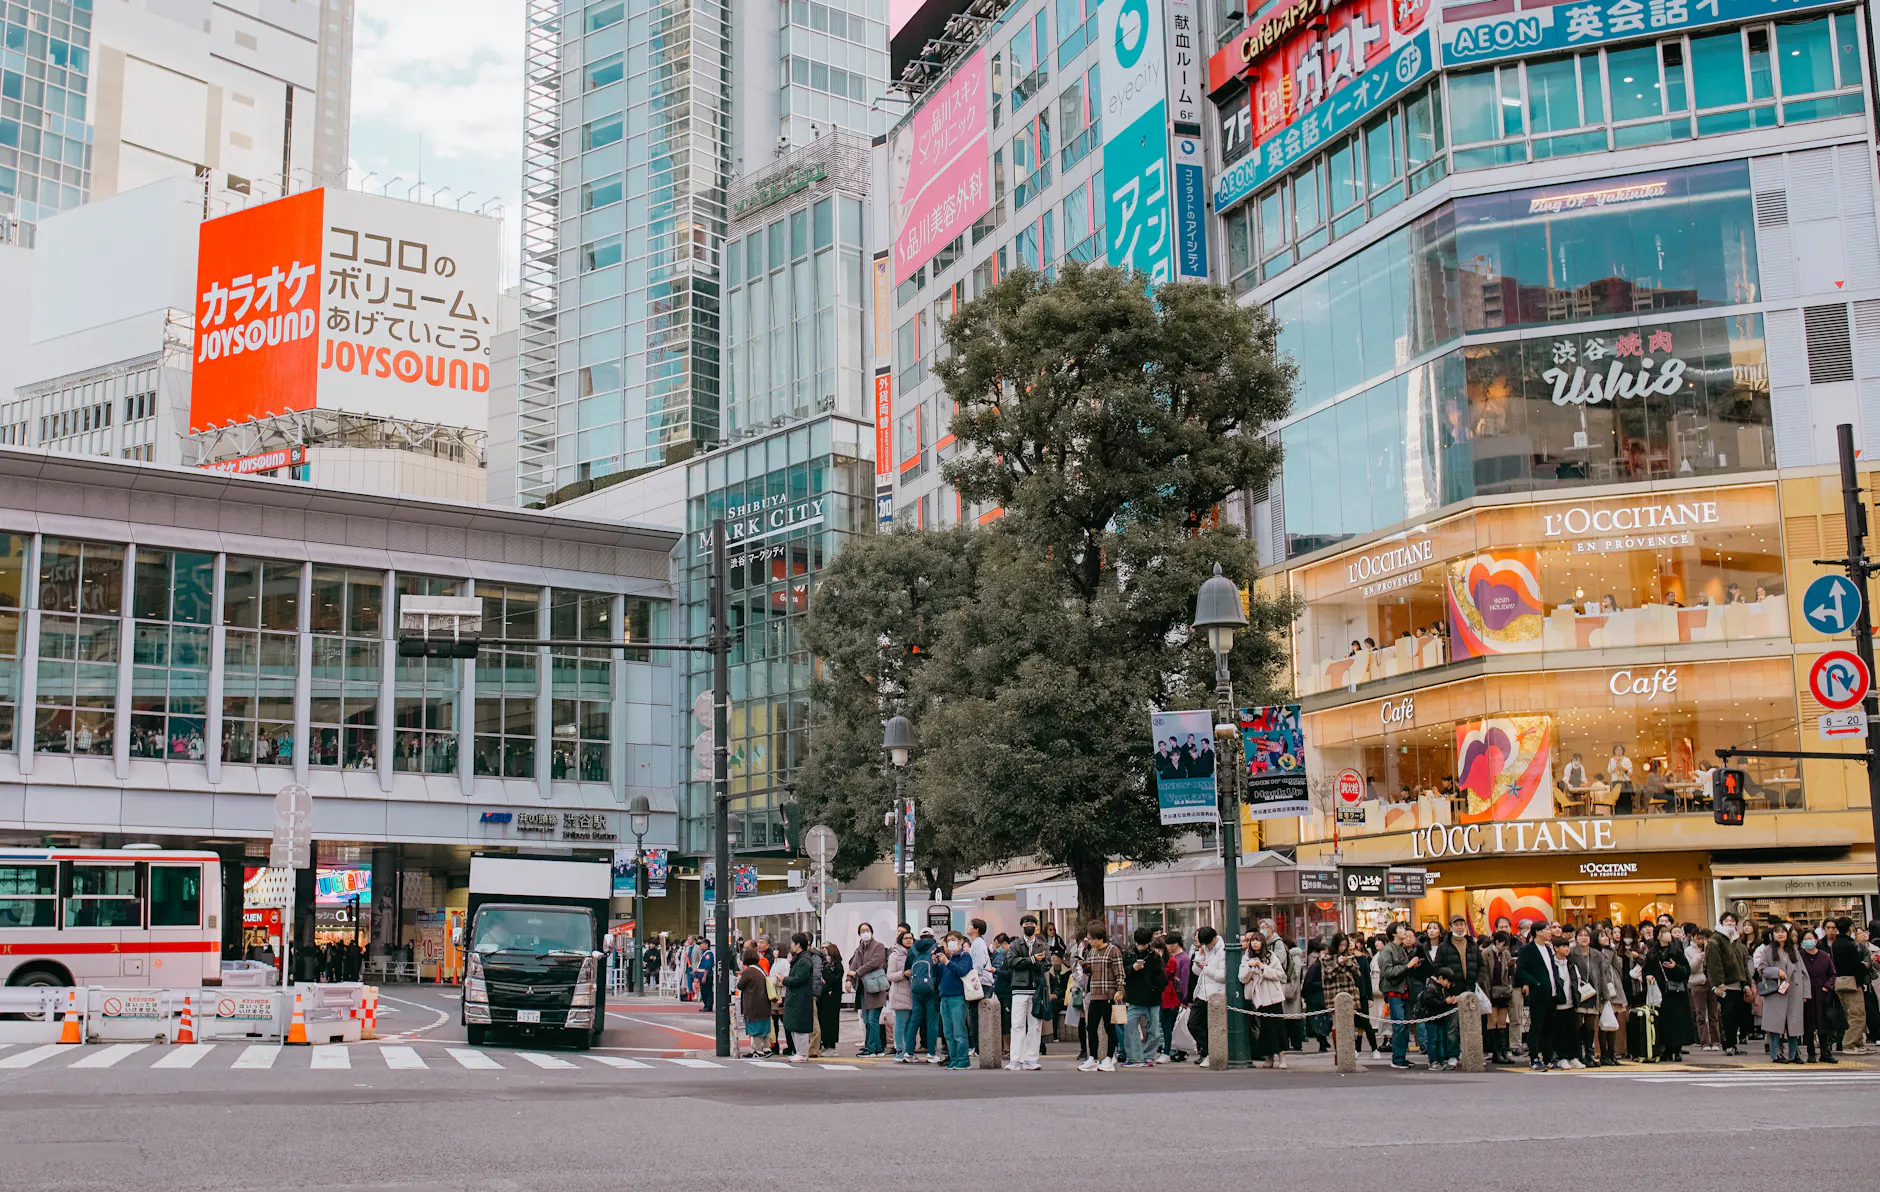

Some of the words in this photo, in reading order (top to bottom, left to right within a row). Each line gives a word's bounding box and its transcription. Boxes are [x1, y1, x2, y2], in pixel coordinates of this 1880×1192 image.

[1455, 19, 1540, 53] AEON
[1174, 14, 1192, 104] 献血ルーム
[1296, 16, 1381, 116] ガスト
[931, 73, 981, 137] 品川スキン
[1109, 58, 1160, 116] eyecity
[1180, 110, 1193, 120] 6F
[1223, 104, 1250, 151] 7F
[932, 105, 976, 164] クリニック
[732, 184, 781, 216] MARK
[783, 162, 825, 190] CITY
[1218, 160, 1256, 203] AEON
[907, 167, 984, 262] 品川美容外科
[330, 226, 456, 278] ココロの
[200, 261, 316, 328] カラオケ
[328, 267, 490, 324] ボリューム、
[198, 308, 316, 363] JOYSOUND
[327, 305, 491, 356] あげていこう。
[1553, 330, 1673, 364] 渋谷焼肉
[321, 339, 490, 393] JOYSOUND
[1542, 358, 1686, 406] Ushi8
[237, 451, 286, 473] JOYSOUND
[292, 451, 301, 461] 9F
[728, 493, 787, 519] SHIBUYA
[770, 499, 825, 528] CITY
[1544, 502, 1720, 536] L'OCCITANE
[1348, 540, 1433, 584] L'OCCITANE
[1577, 542, 1596, 552] EN
[1605, 534, 1691, 549] PROVENCE
[1364, 585, 1374, 596] EN
[1377, 572, 1420, 592] PROVENCE
[1609, 669, 1677, 701] Café
[1380, 698, 1414, 727] Café
[1826, 718, 1832, 727] 8
[1847, 715, 1859, 725] 20
[480, 812, 513, 823] KEIO
[563, 812, 607, 829] 渋谷駅
[563, 830, 590, 840] Shibuya
[592, 831, 618, 840] Station
[1579, 862, 1638, 873] L'OCCITANE
[1785, 879, 1814, 892] ploom
[1817, 880, 1853, 888] STATION
